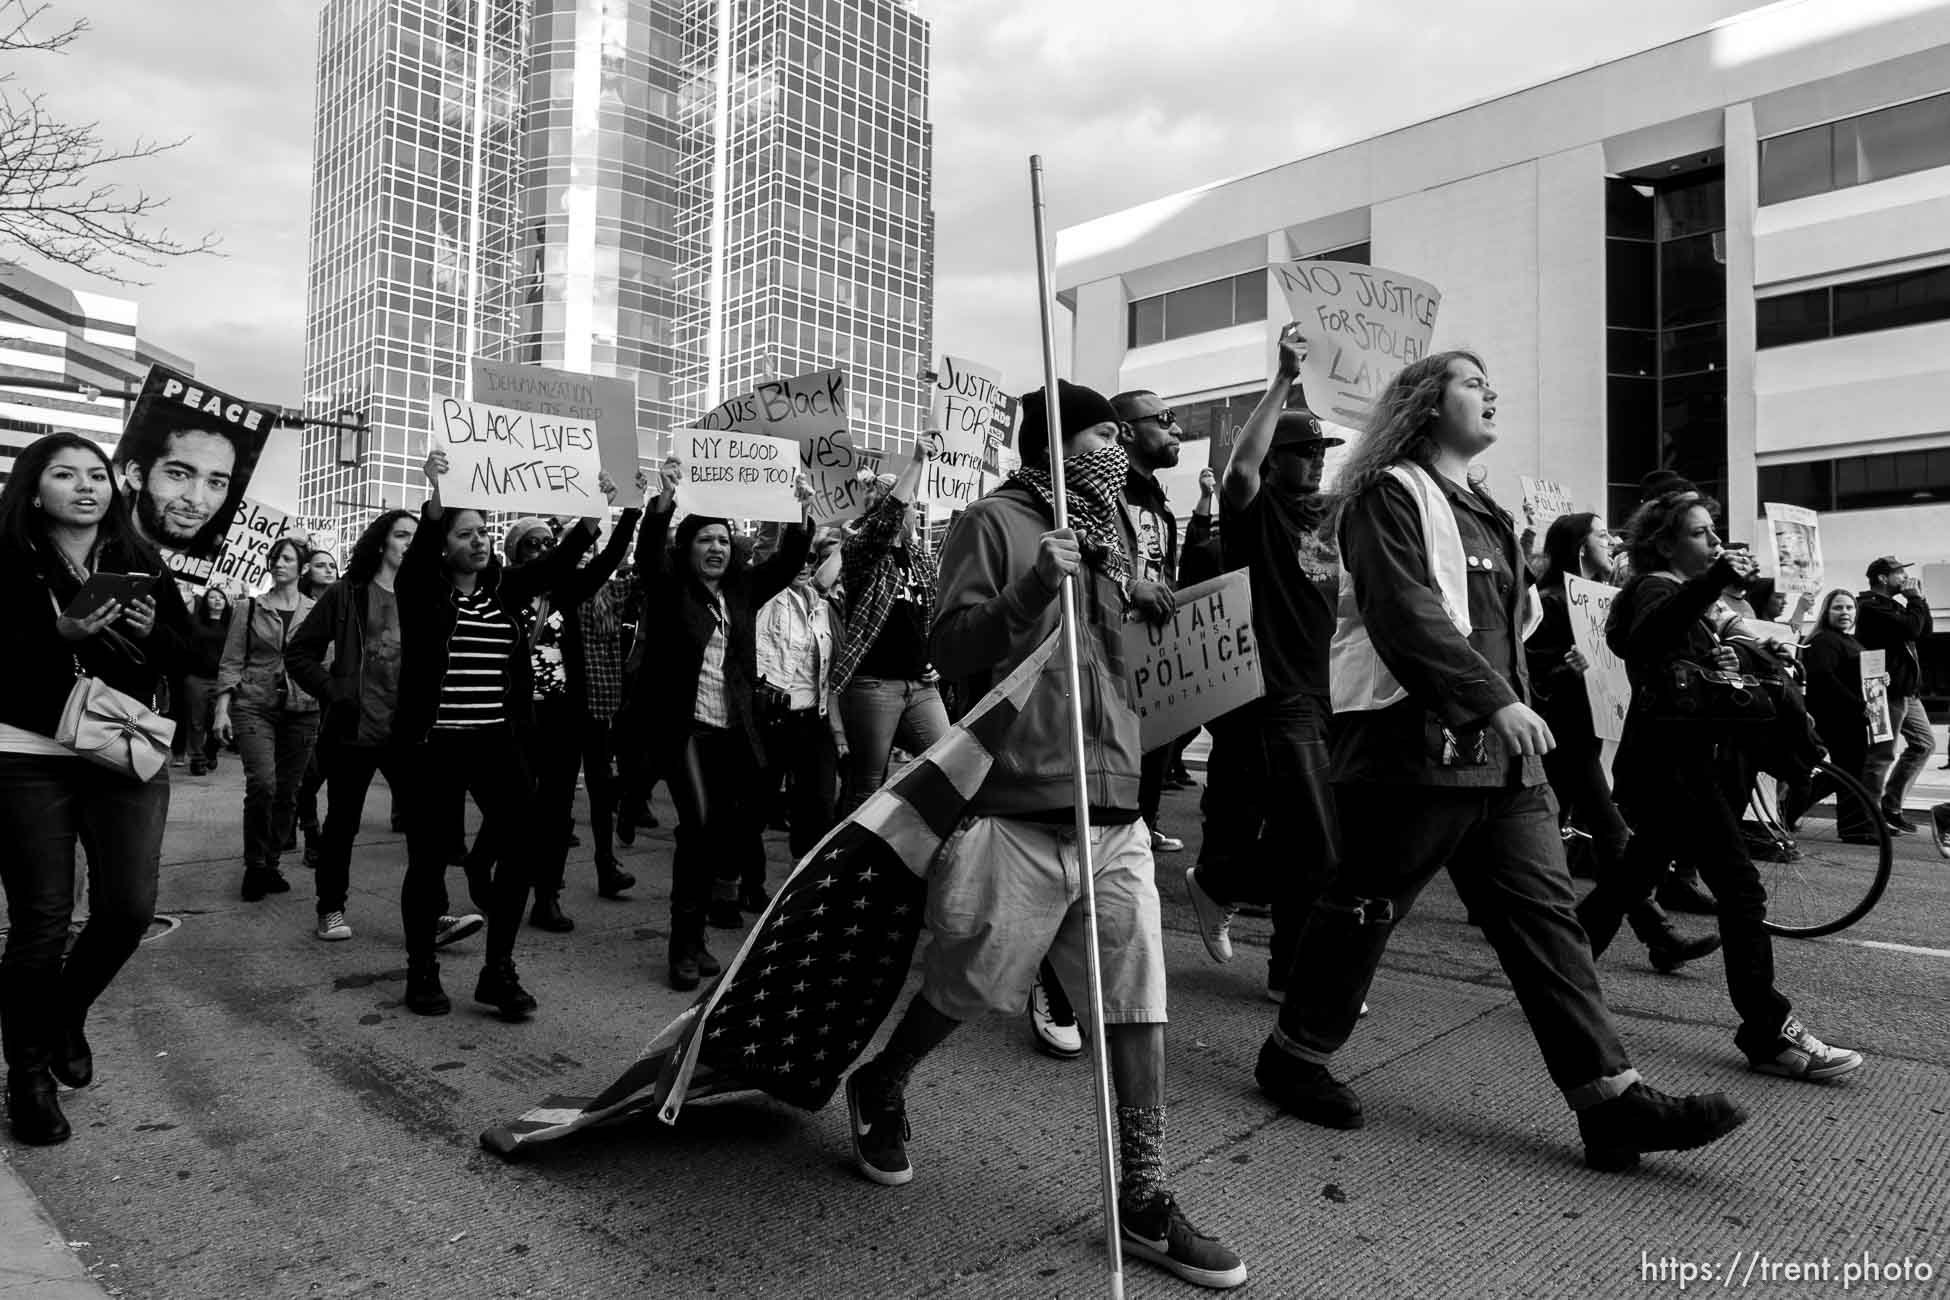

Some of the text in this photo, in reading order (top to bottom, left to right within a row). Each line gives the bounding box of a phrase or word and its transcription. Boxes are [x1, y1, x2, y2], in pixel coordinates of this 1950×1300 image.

[1280, 265, 1436, 329] NO JUSTICE
[1315, 304, 1355, 335] FOR
[162, 378, 263, 431] PEACE
[442, 399, 593, 452] BLACK LIVES
[943, 395, 989, 444] FOR
[692, 437, 778, 461] MY BLOOD
[471, 456, 589, 497] MATTER
[691, 466, 797, 489] BLEEDS RED TOO!
[802, 471, 858, 519] tter
[225, 531, 269, 556] ive
[231, 501, 290, 540] Black
[1147, 592, 1224, 646] UTAH
[1135, 624, 1251, 697] POLICE
